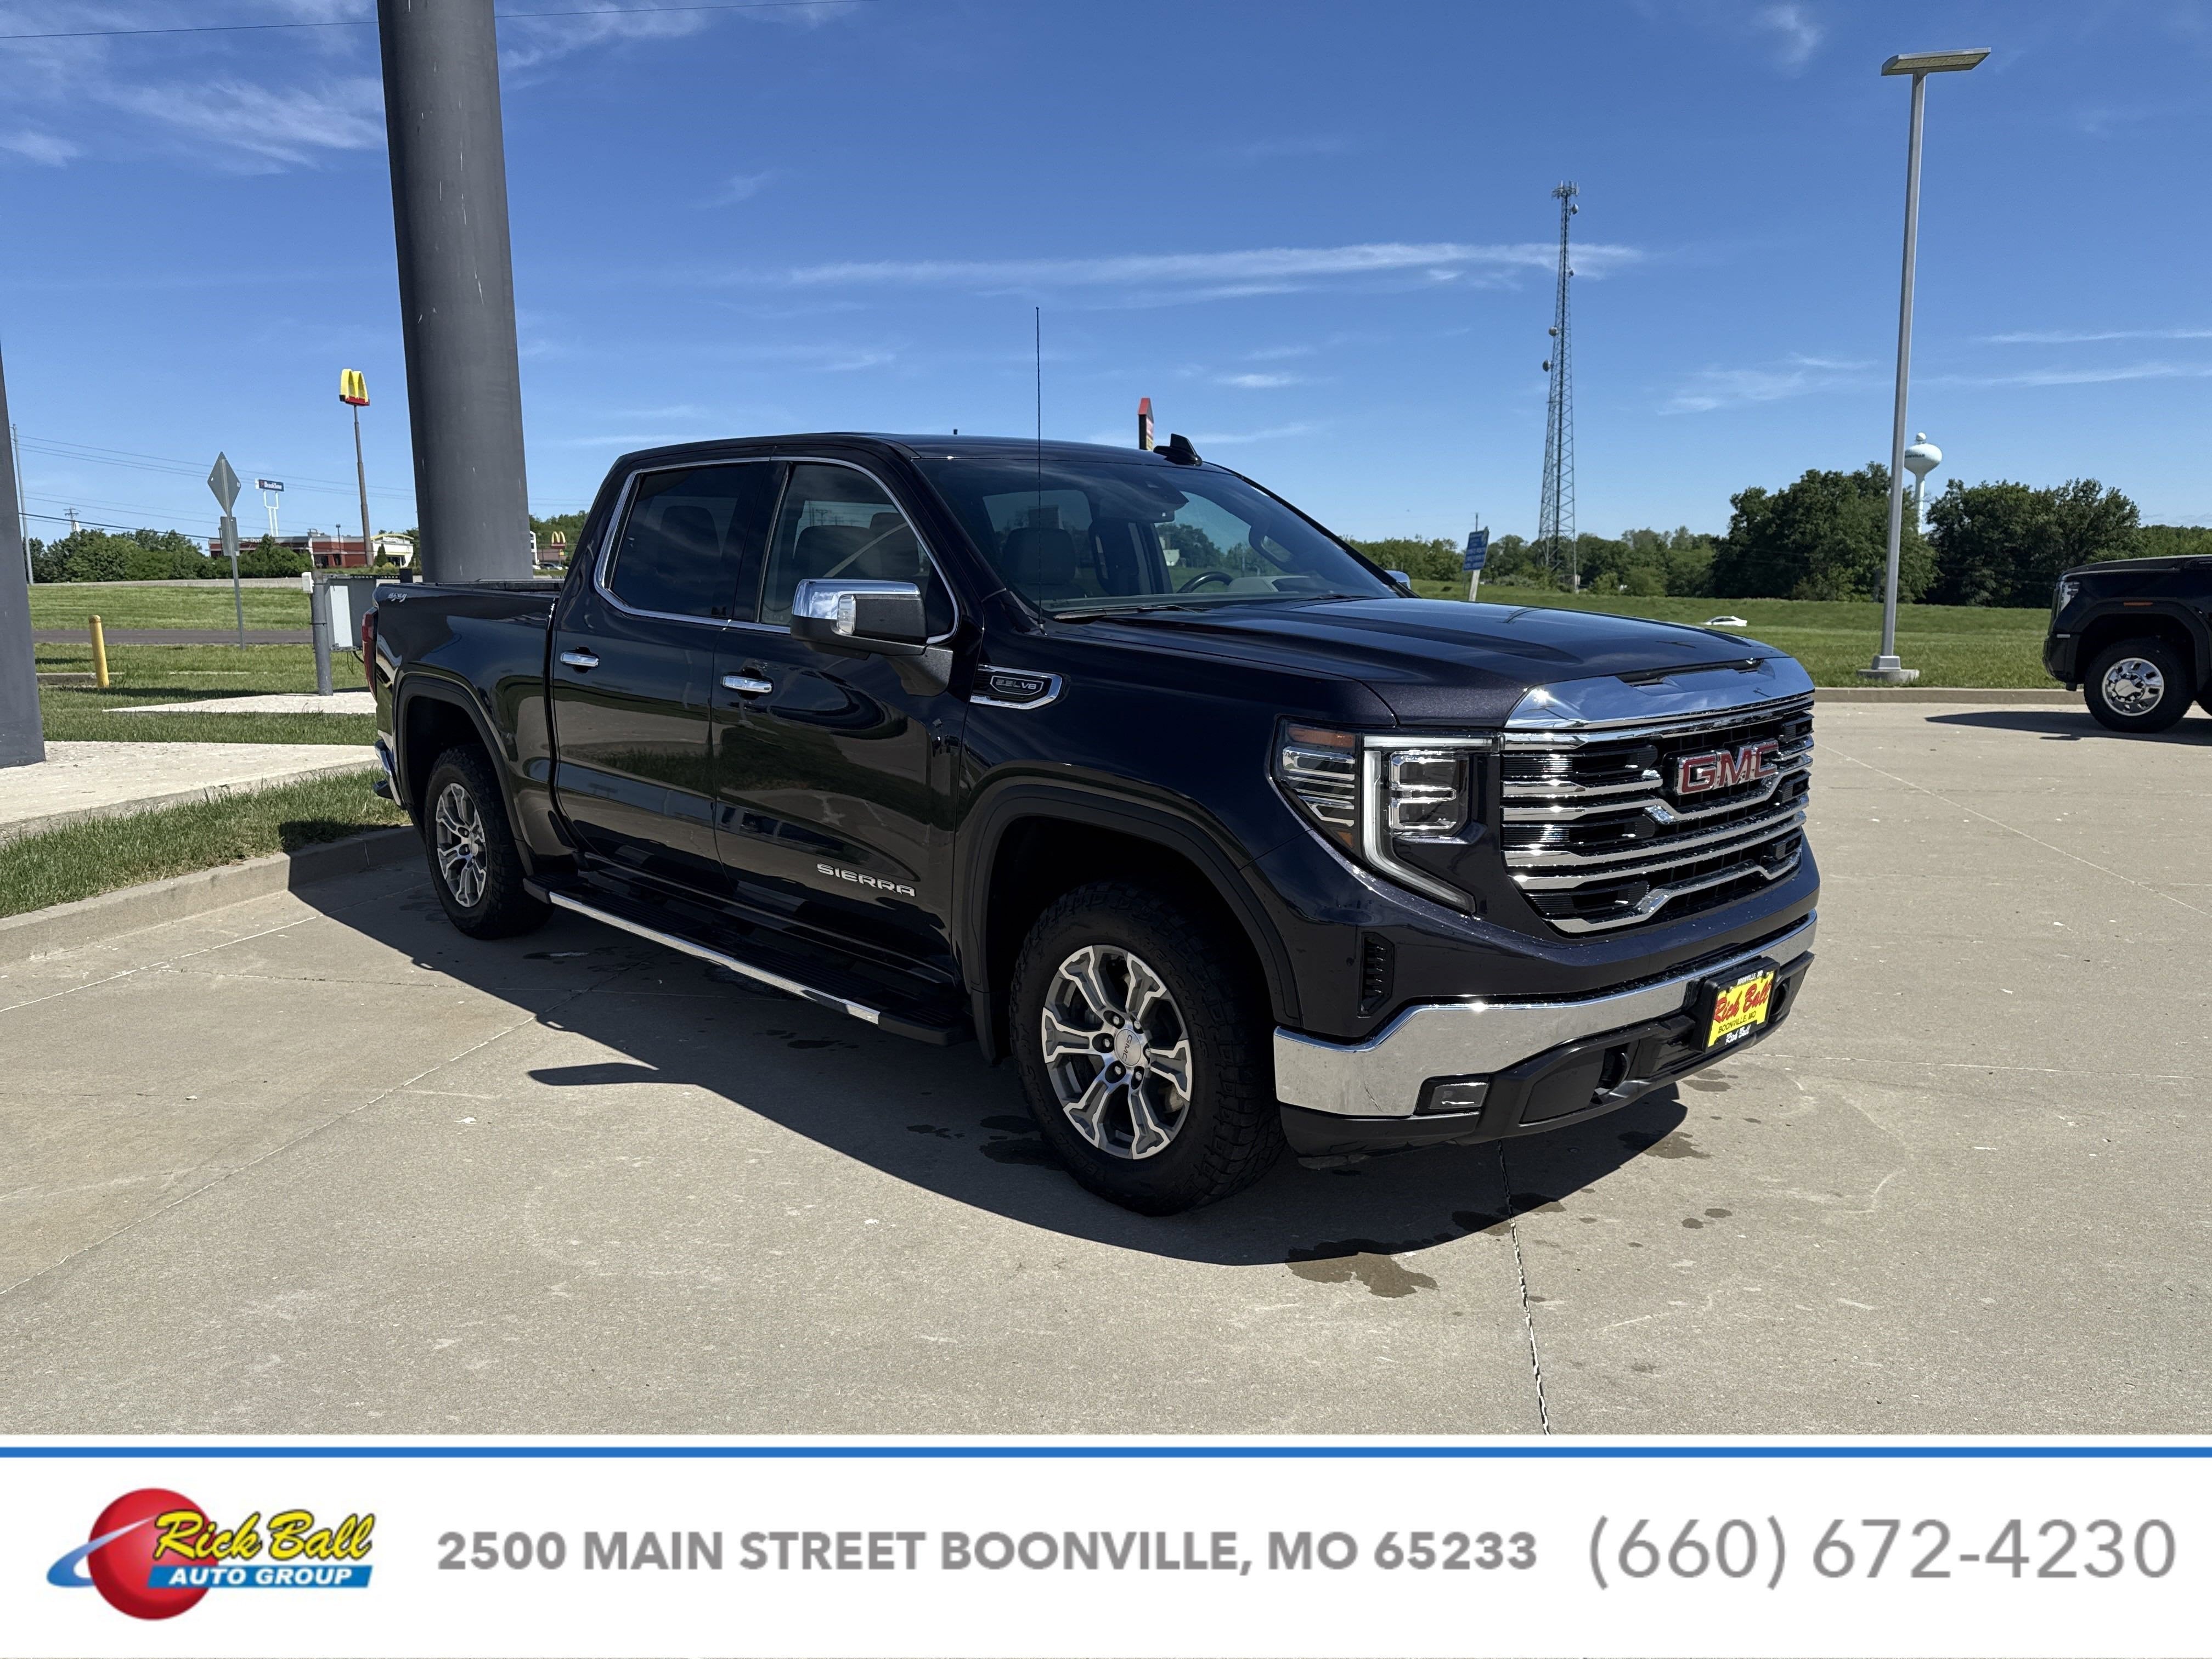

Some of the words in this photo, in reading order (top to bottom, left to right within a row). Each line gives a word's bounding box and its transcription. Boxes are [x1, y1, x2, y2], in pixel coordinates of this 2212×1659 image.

[1677, 739, 1779, 795] GMC
[817, 863, 916, 896] SIERRA
[1713, 991, 1743, 1024] Rick
[1743, 979, 1773, 1013] Ball
[1748, 1011, 1756, 1020] MO
[1122, 1034, 1132, 1061] GMC
